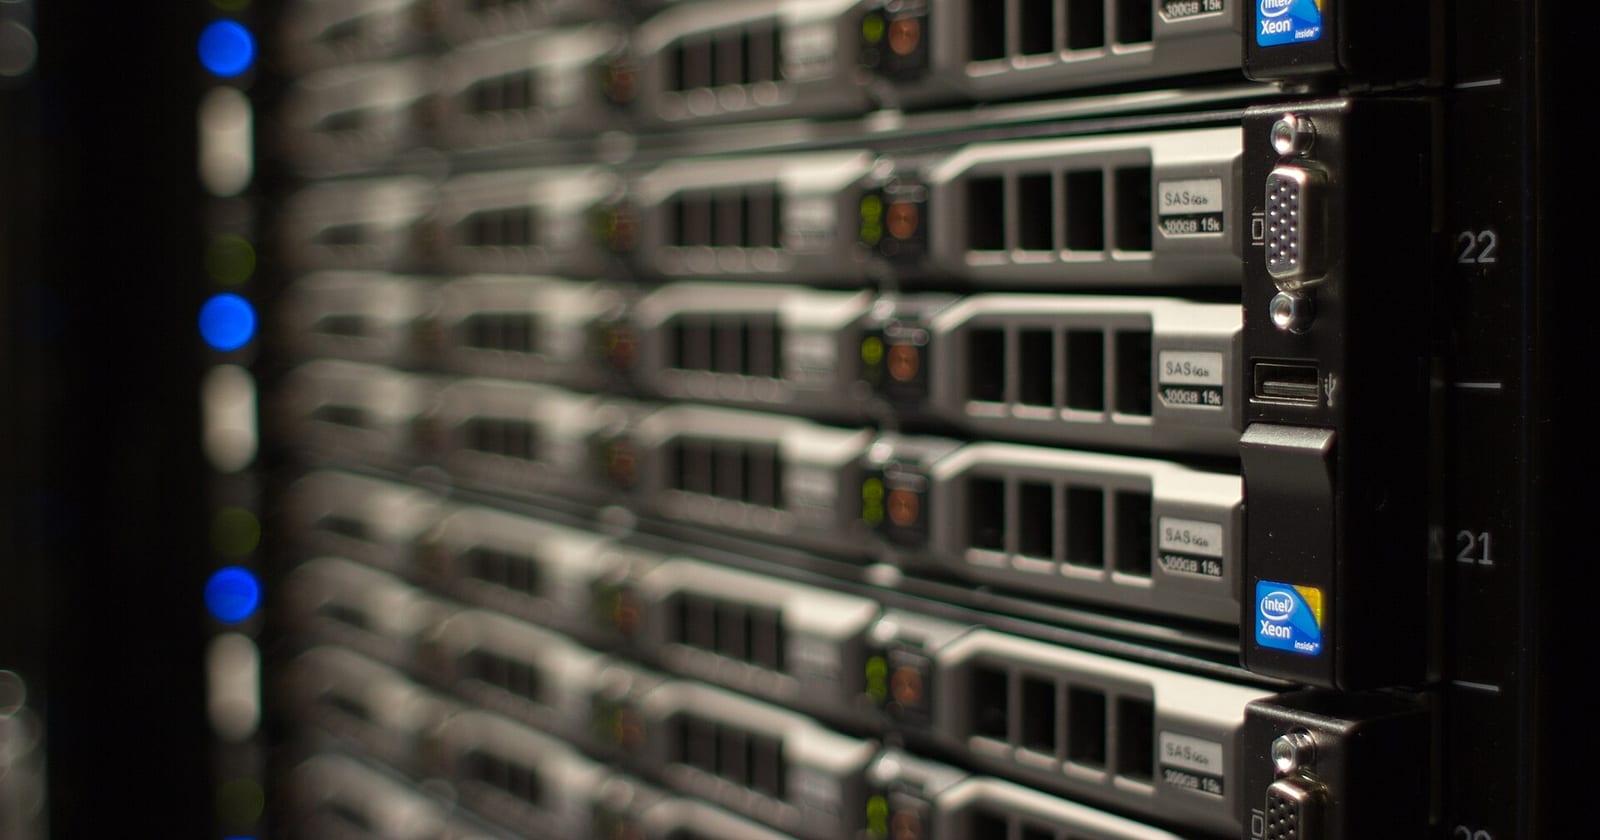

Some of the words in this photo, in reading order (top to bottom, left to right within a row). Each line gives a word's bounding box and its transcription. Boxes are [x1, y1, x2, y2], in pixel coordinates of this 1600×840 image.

[1261, 19, 1291, 35] Xeon
[1165, 191, 1189, 206] SAS
[1165, 219, 1197, 233] 300GB
[1201, 217, 1220, 231] 15k
[1458, 230, 1496, 263] 22
[1166, 361, 1191, 376] SAS
[1165, 389, 1198, 404] 300GB
[1202, 390, 1221, 404] 15k
[1166, 528, 1190, 544] SAS
[1457, 530, 1493, 565] 21
[1201, 560, 1220, 575] 15k
[1264, 596, 1288, 612] intel
[1261, 619, 1291, 639] Xeon
